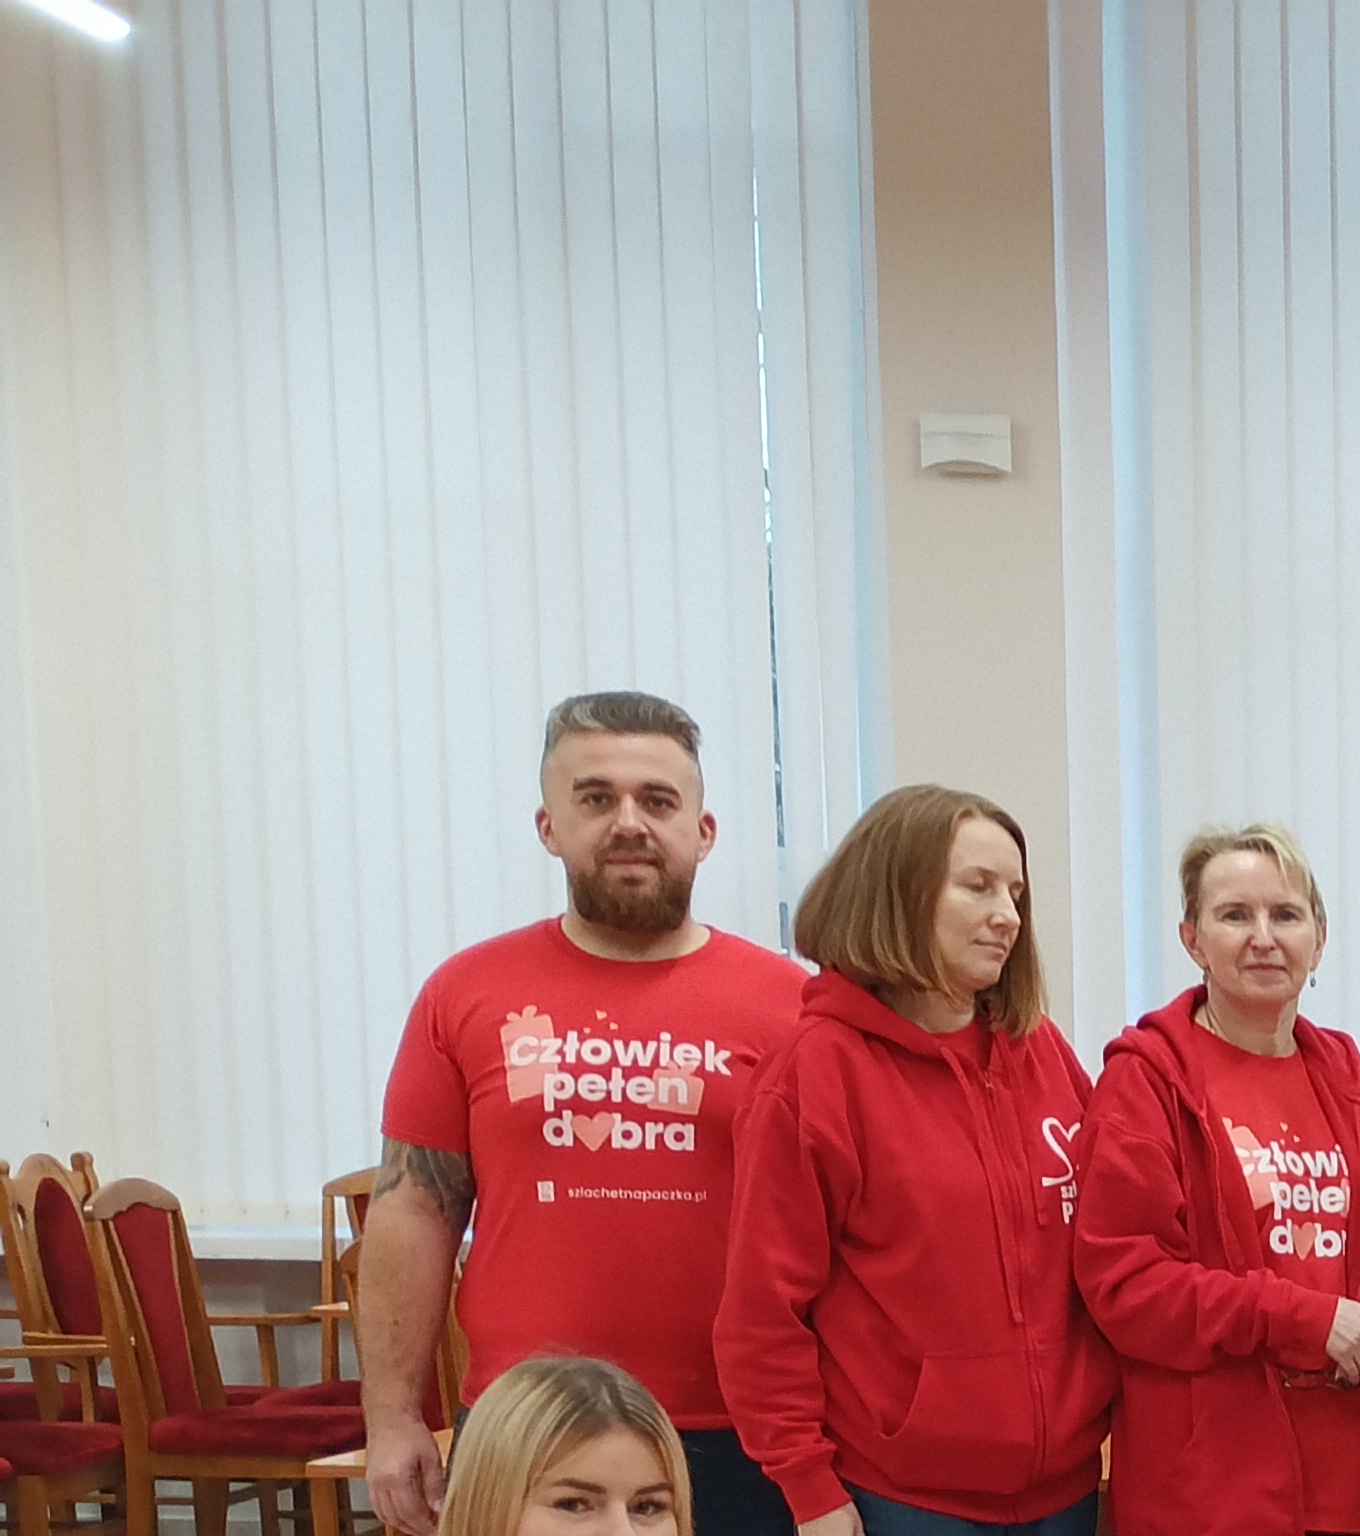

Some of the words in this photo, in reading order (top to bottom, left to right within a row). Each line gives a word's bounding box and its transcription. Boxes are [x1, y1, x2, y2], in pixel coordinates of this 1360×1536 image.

[544, 1067, 689, 1112] pełen
[568, 1186, 708, 1203] szlachetnapaczka.pl
[1270, 1178, 1350, 1220] pełe
